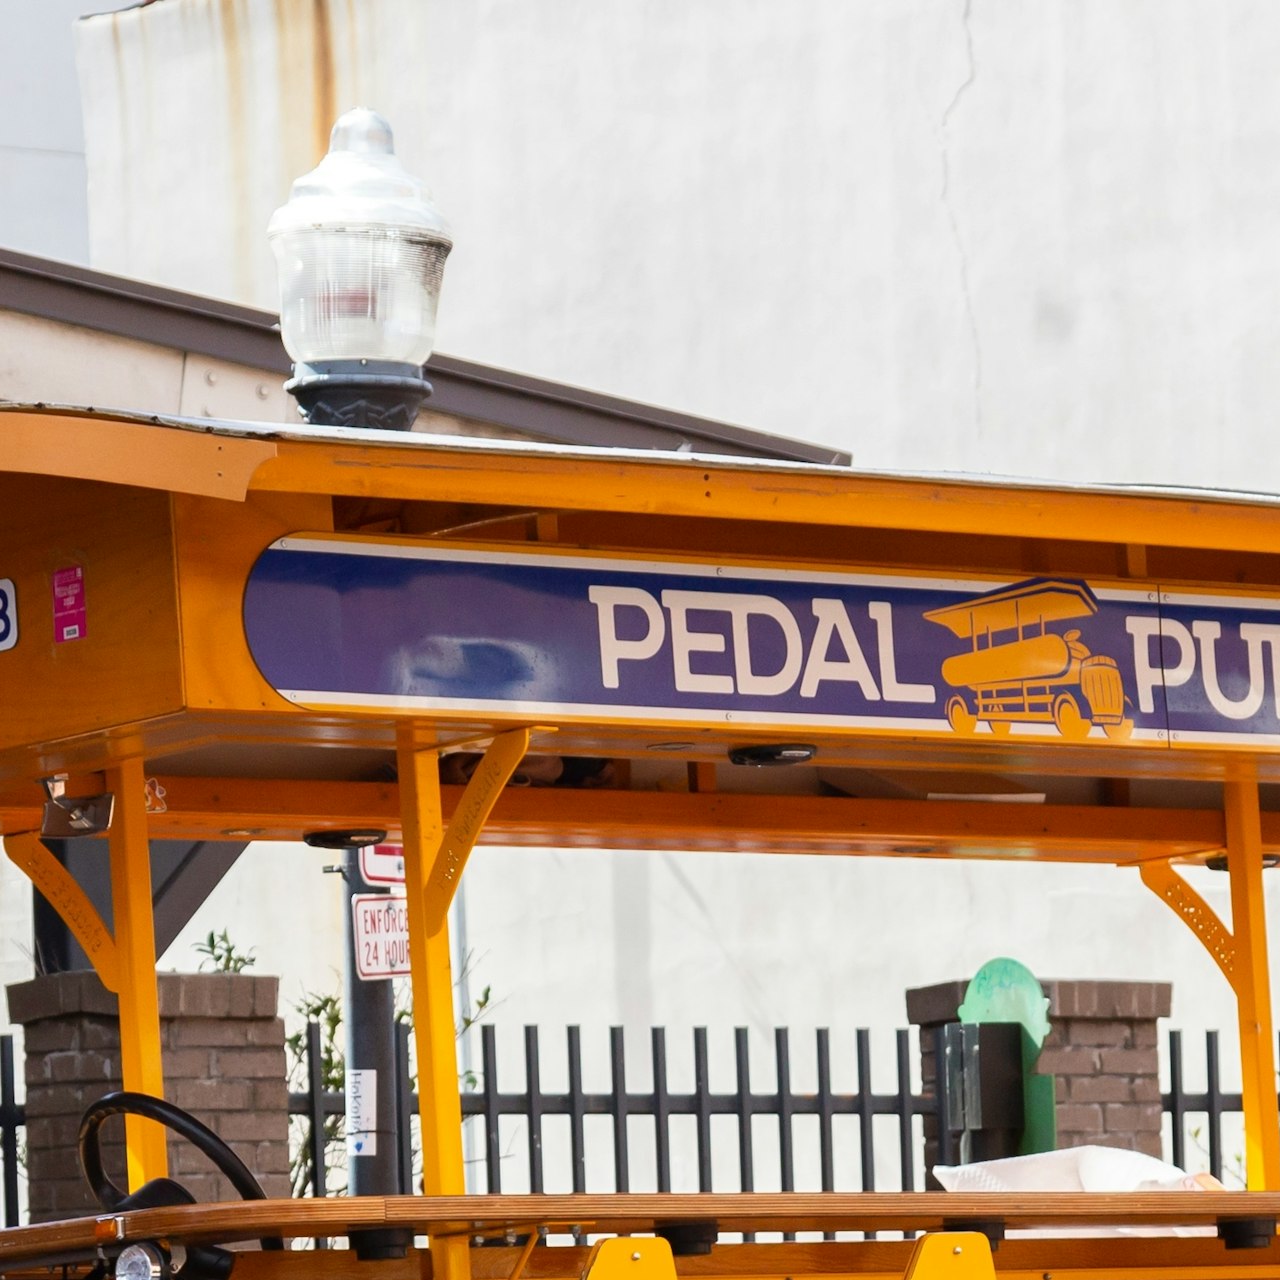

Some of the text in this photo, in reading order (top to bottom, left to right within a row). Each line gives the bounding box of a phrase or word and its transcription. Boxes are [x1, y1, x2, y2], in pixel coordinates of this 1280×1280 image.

[588, 585, 937, 704] PEDAL
[364, 908, 409, 934] ENFORCE
[365, 940, 411, 967] 24 HOUR
